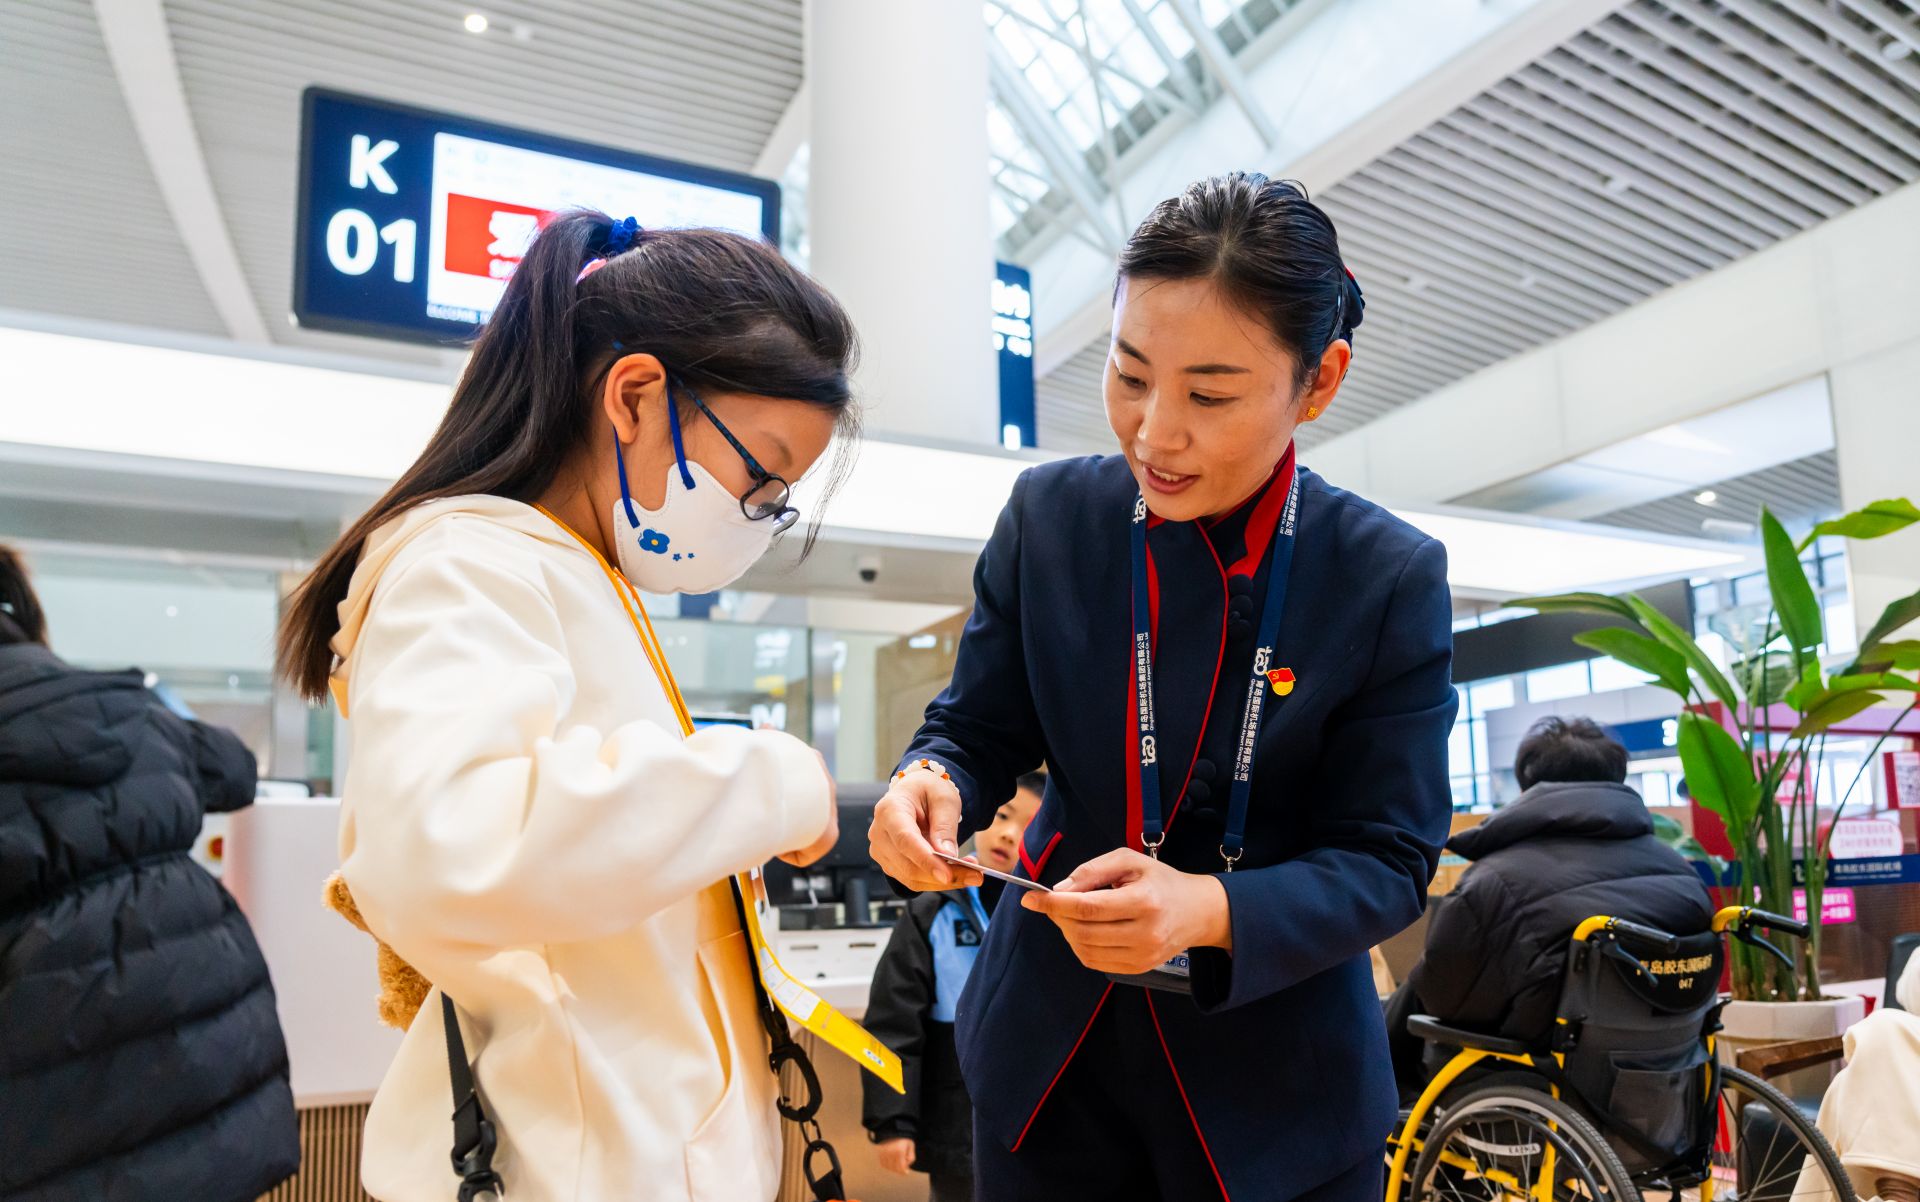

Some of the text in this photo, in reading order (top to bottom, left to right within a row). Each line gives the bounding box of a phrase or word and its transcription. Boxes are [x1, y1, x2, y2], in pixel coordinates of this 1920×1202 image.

[348, 133, 400, 195] K
[326, 208, 417, 284] 01
[1137, 633, 1149, 731] 青岛国际机场集团有限公司
[1247, 678, 1256, 698] Qingdao
[1239, 729, 1247, 746] Airport
[1240, 680, 1264, 781] 青岛国际机场集团有限公司
[1242, 698, 1252, 729] International
